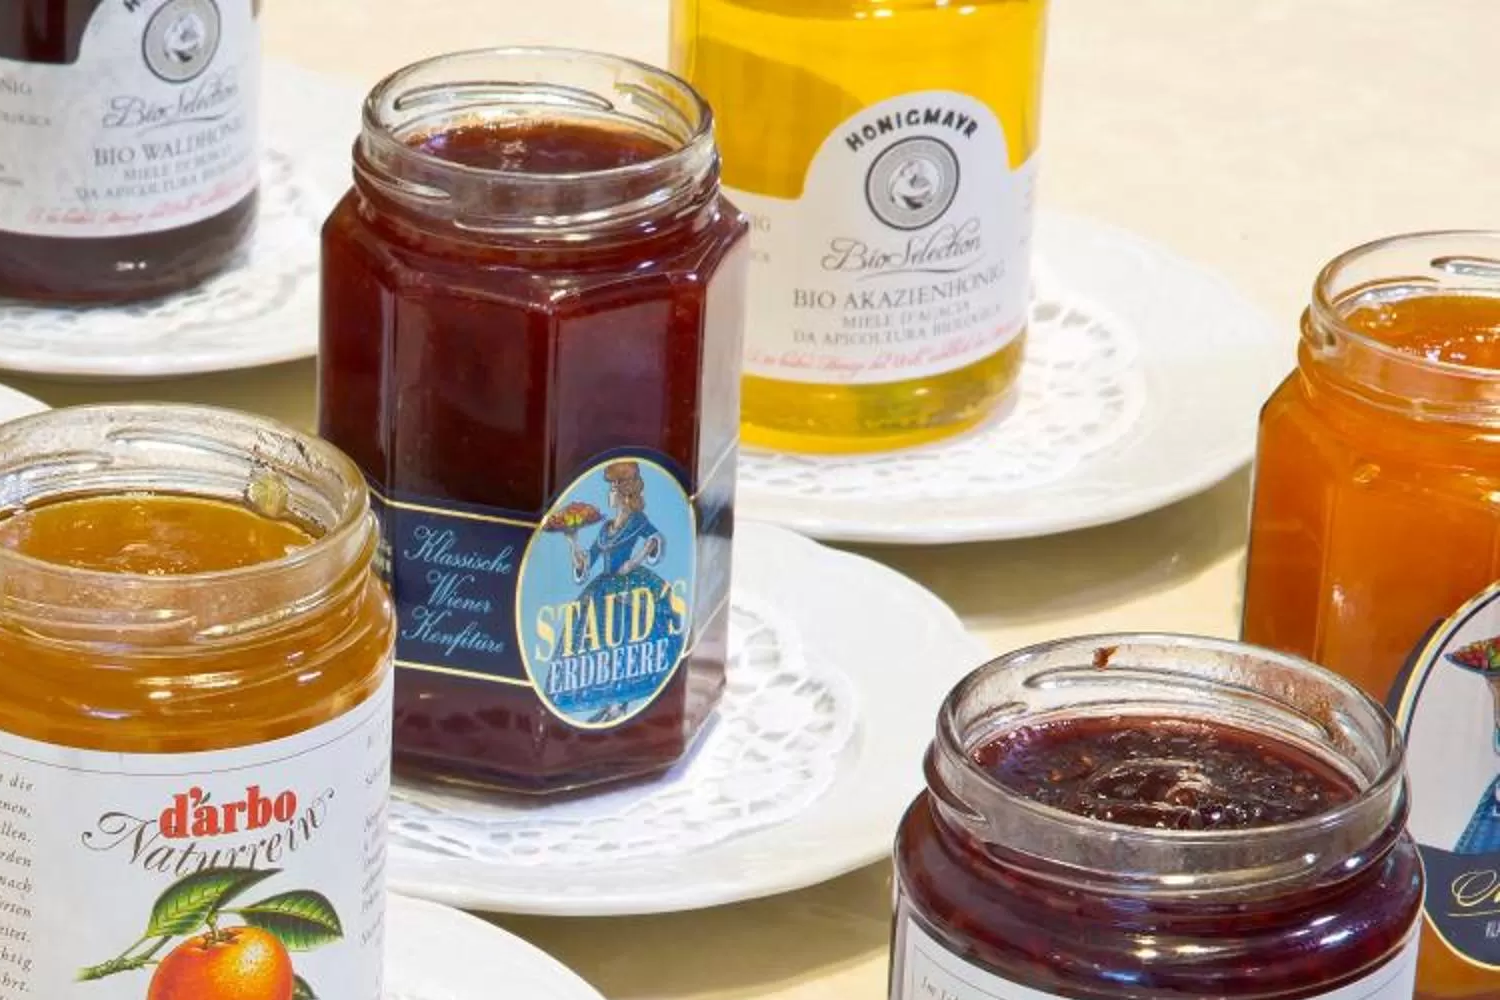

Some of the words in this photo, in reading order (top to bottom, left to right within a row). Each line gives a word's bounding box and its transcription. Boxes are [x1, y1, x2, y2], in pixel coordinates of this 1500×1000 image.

[845, 108, 979, 152] HONIGMAYR
[793, 288, 837, 309] BIO
[404, 524, 515, 575] Klassische
[534, 579, 688, 662] STAUD'S
[548, 636, 670, 695] ERDBEERE
